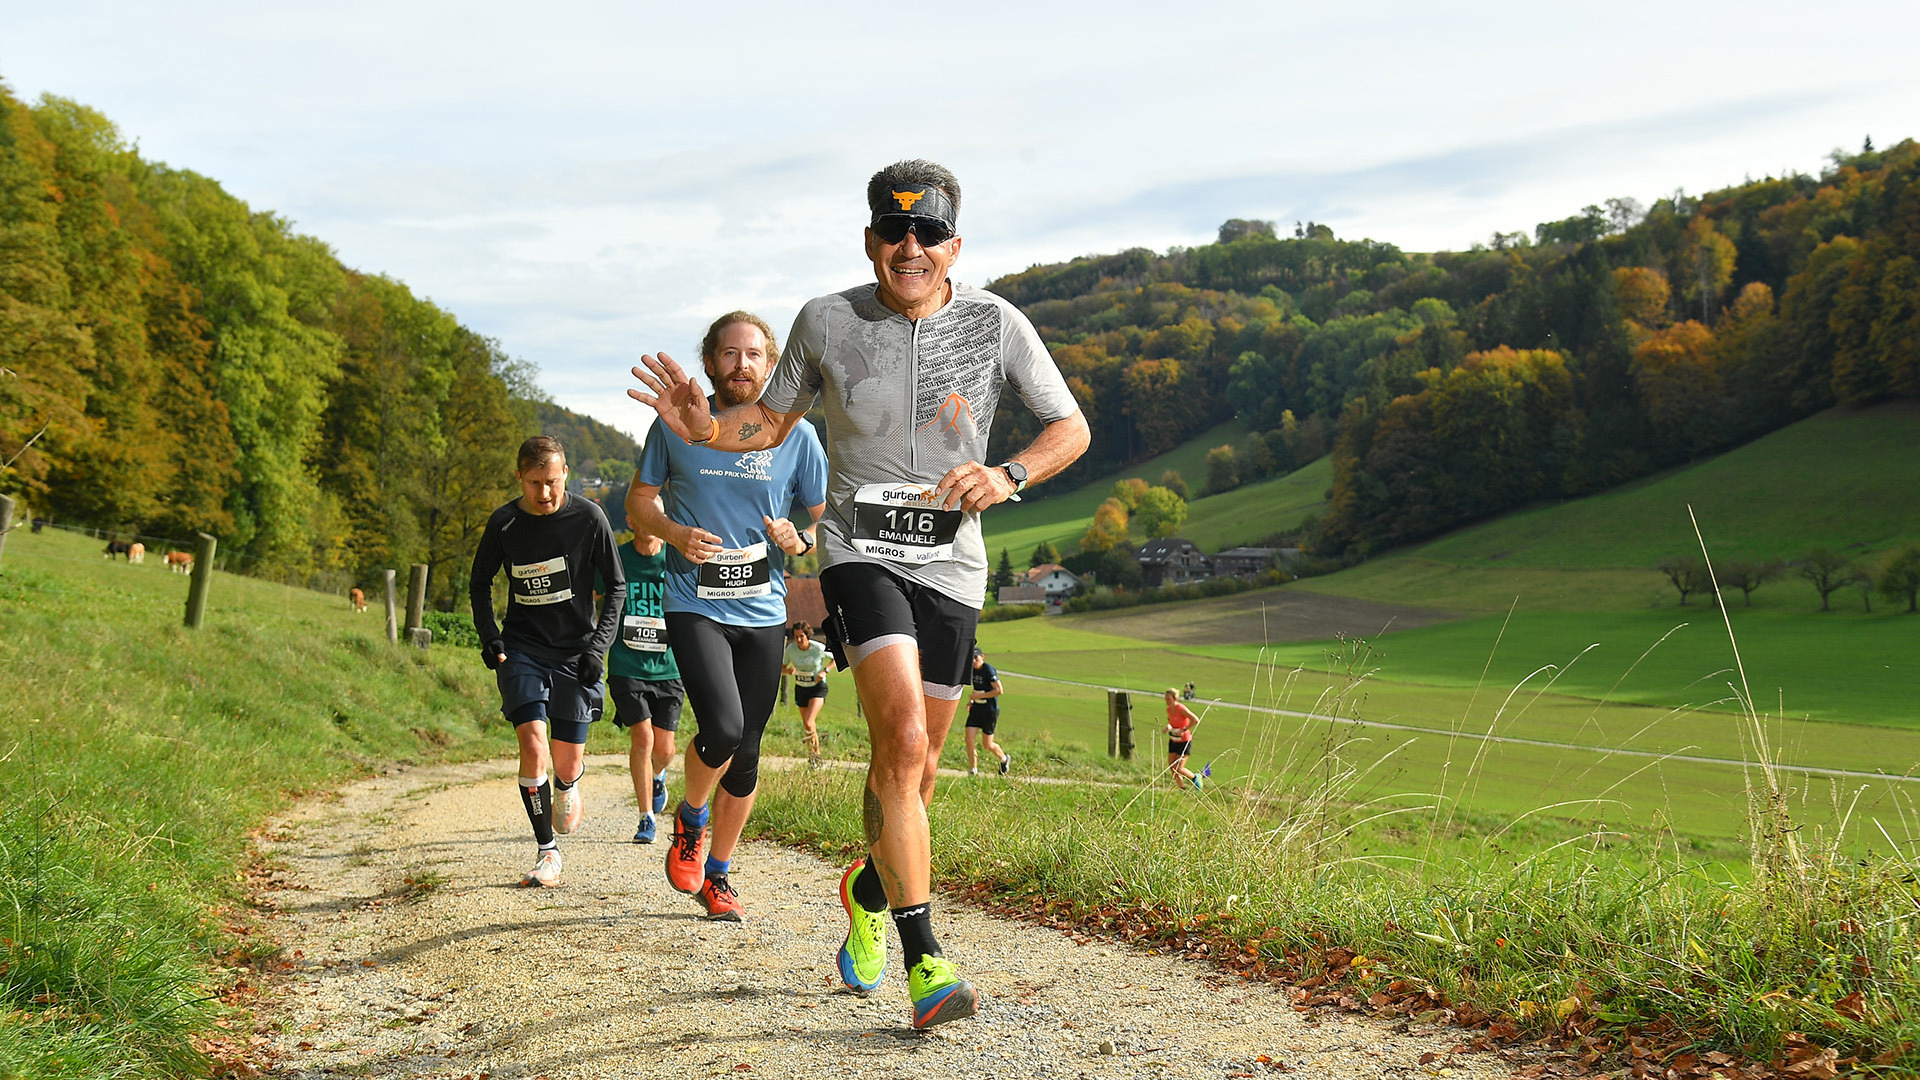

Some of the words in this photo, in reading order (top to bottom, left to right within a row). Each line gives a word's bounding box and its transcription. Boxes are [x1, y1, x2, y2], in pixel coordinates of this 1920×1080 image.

[882, 490, 920, 501] gurten
[885, 510, 935, 533] 116
[879, 530, 936, 544] EMANUELE
[717, 553, 743, 561] gurten
[865, 546, 905, 558] MIGROS
[518, 568, 539, 576] gurten
[719, 565, 753, 579] 338
[523, 576, 551, 589] 195
[636, 628, 657, 638] 105
